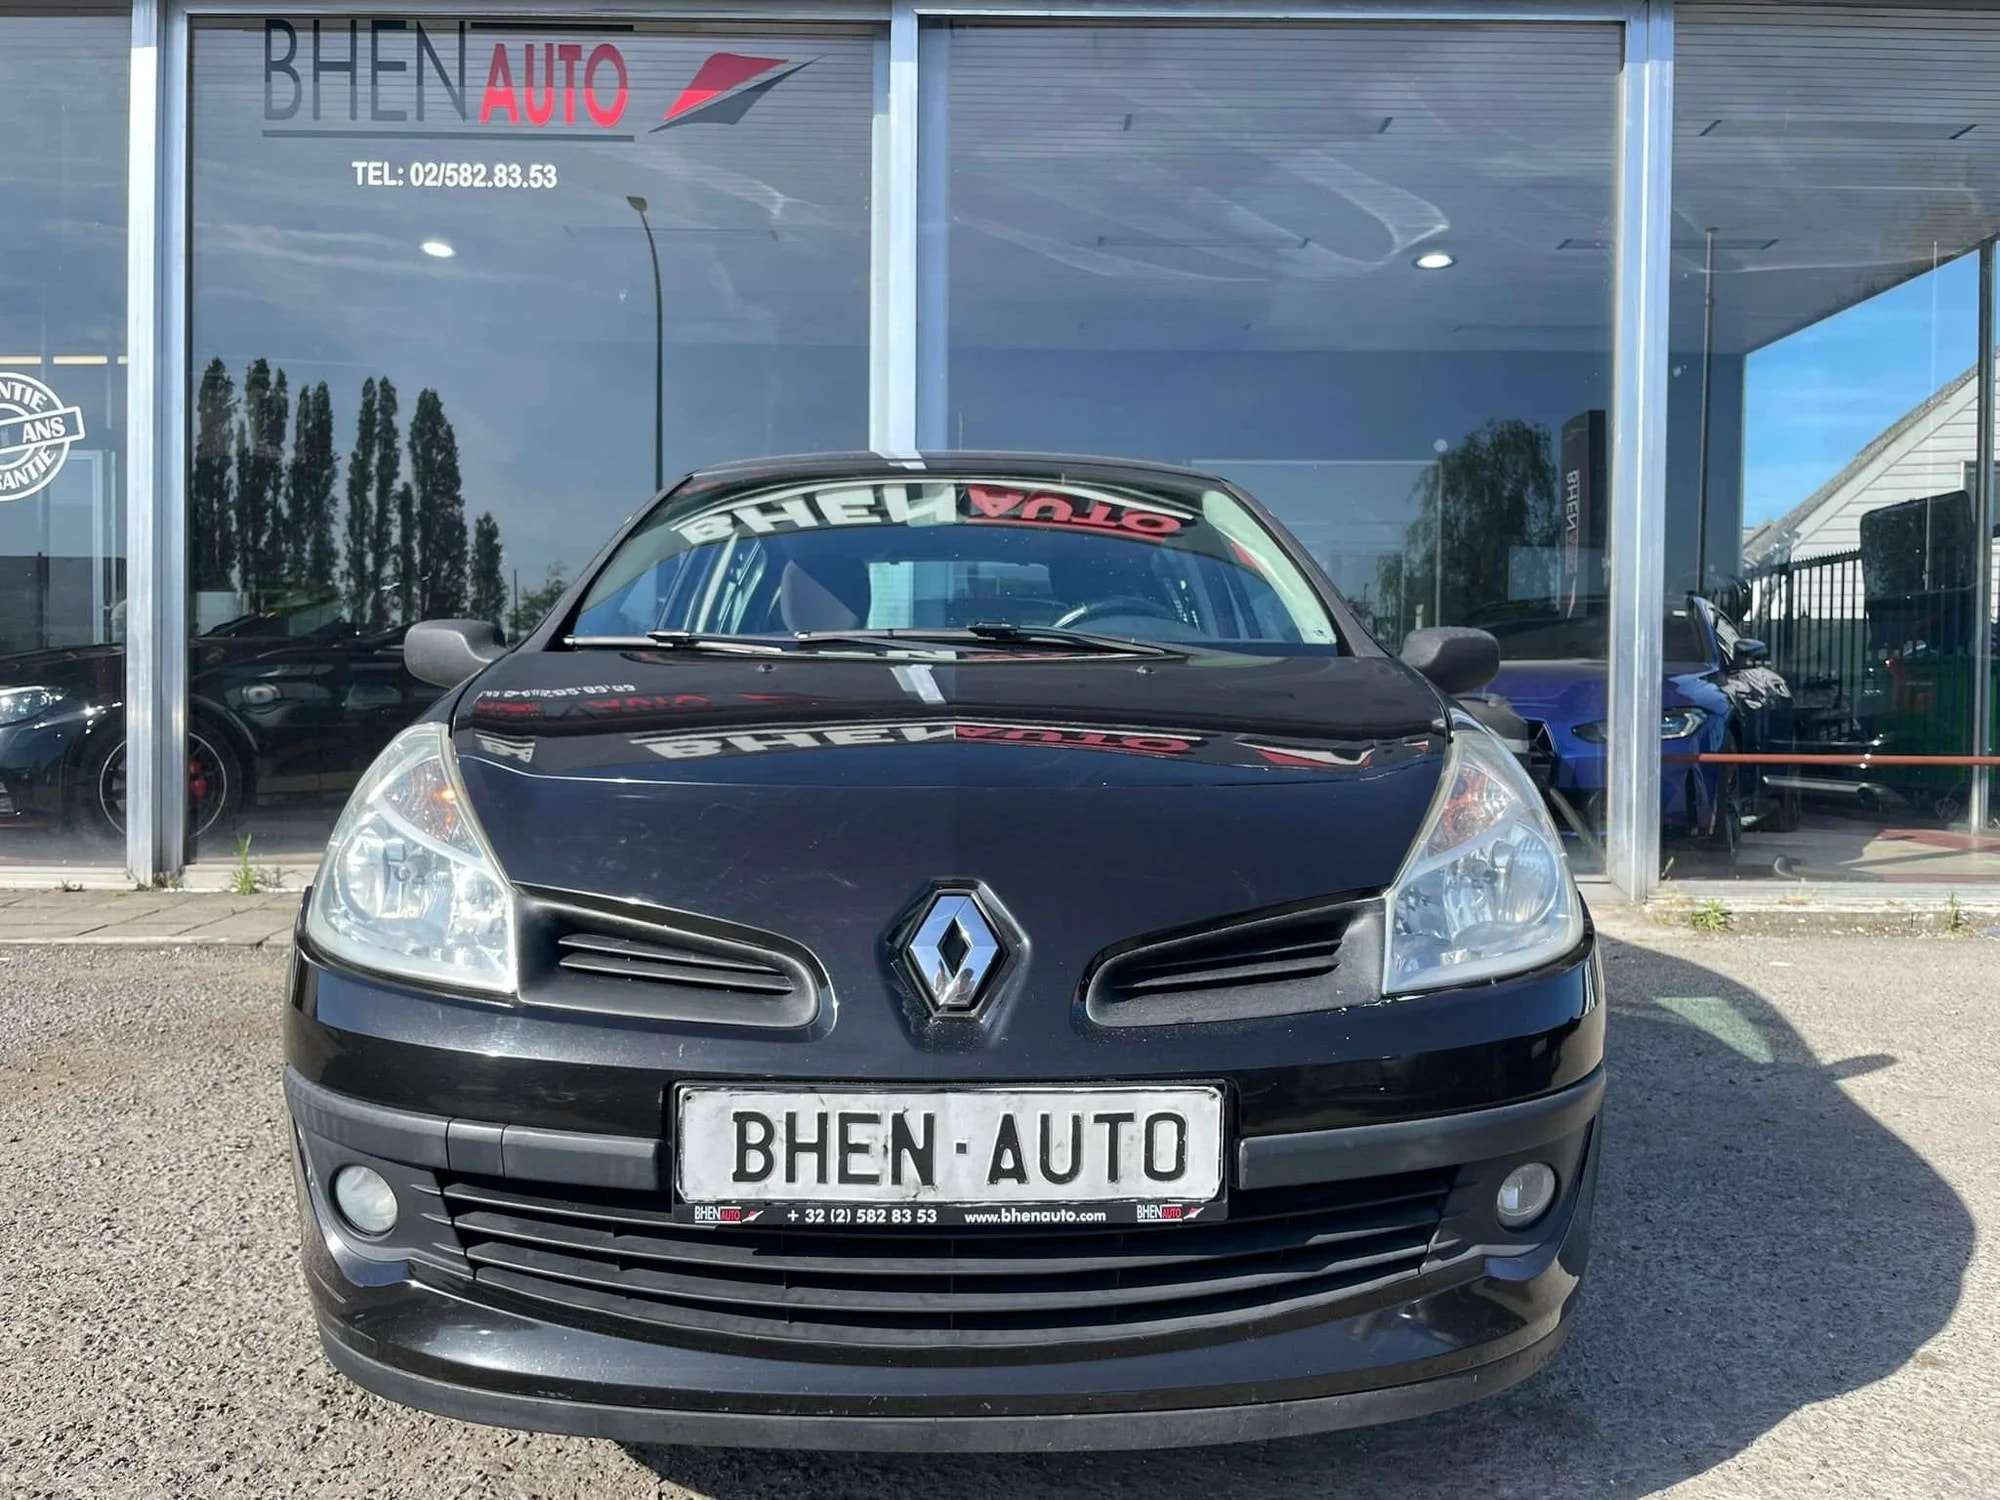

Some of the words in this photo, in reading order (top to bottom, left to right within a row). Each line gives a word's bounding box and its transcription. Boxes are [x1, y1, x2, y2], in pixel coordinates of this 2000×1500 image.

[264, 19, 467, 122] BHEN
[478, 43, 629, 128] AUTO
[351, 161, 404, 187] TEL:
[409, 162, 558, 189] 02/582.83.53
[22, 416, 66, 444] ANS
[732, 1110, 936, 1185] BHEN
[987, 1112, 1188, 1184] AUTO
[694, 1206, 720, 1220] BHEN
[805, 1209, 825, 1222] 32
[830, 1208, 851, 1224] (2)
[856, 1209, 886, 1222] 582
[891, 1209, 912, 1222] 83
[916, 1209, 937, 1222] 53
[964, 1208, 1107, 1223] www.bhenauto.com
[1137, 1204, 1162, 1219] BHEN
